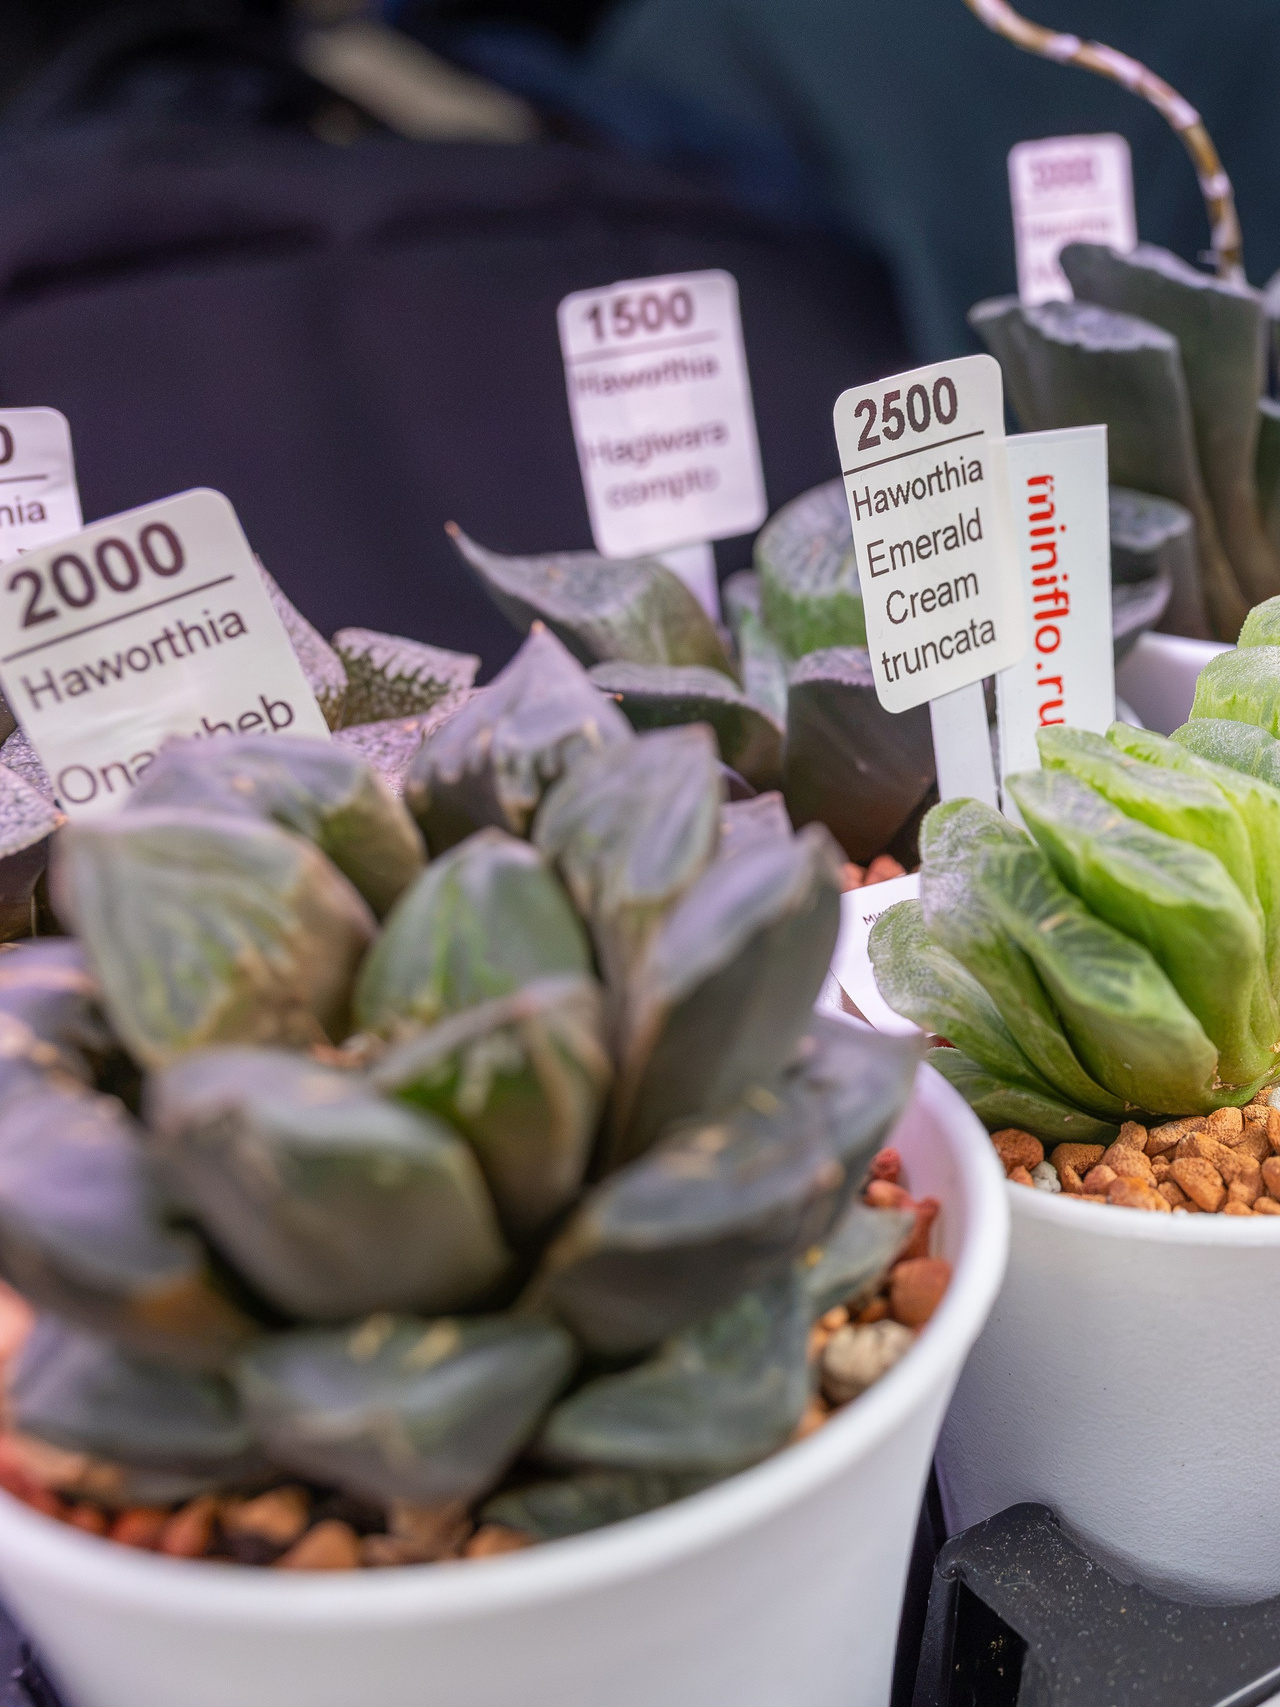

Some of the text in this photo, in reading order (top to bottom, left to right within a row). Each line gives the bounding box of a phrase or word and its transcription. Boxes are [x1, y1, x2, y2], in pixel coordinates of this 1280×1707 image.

[580, 286, 695, 342] 1500
[572, 355, 719, 396] Haworthia
[584, 420, 728, 466] Hagiwara
[853, 376, 959, 452] 2500
[852, 455, 985, 522] Haworthia
[8, 521, 186, 630] 2000
[866, 507, 984, 579] Emerald
[885, 572, 980, 625] Cream
[1026, 474, 1071, 728] miniflo.ru
[19, 609, 249, 711] Haworthia
[881, 619, 997, 683] truncata
